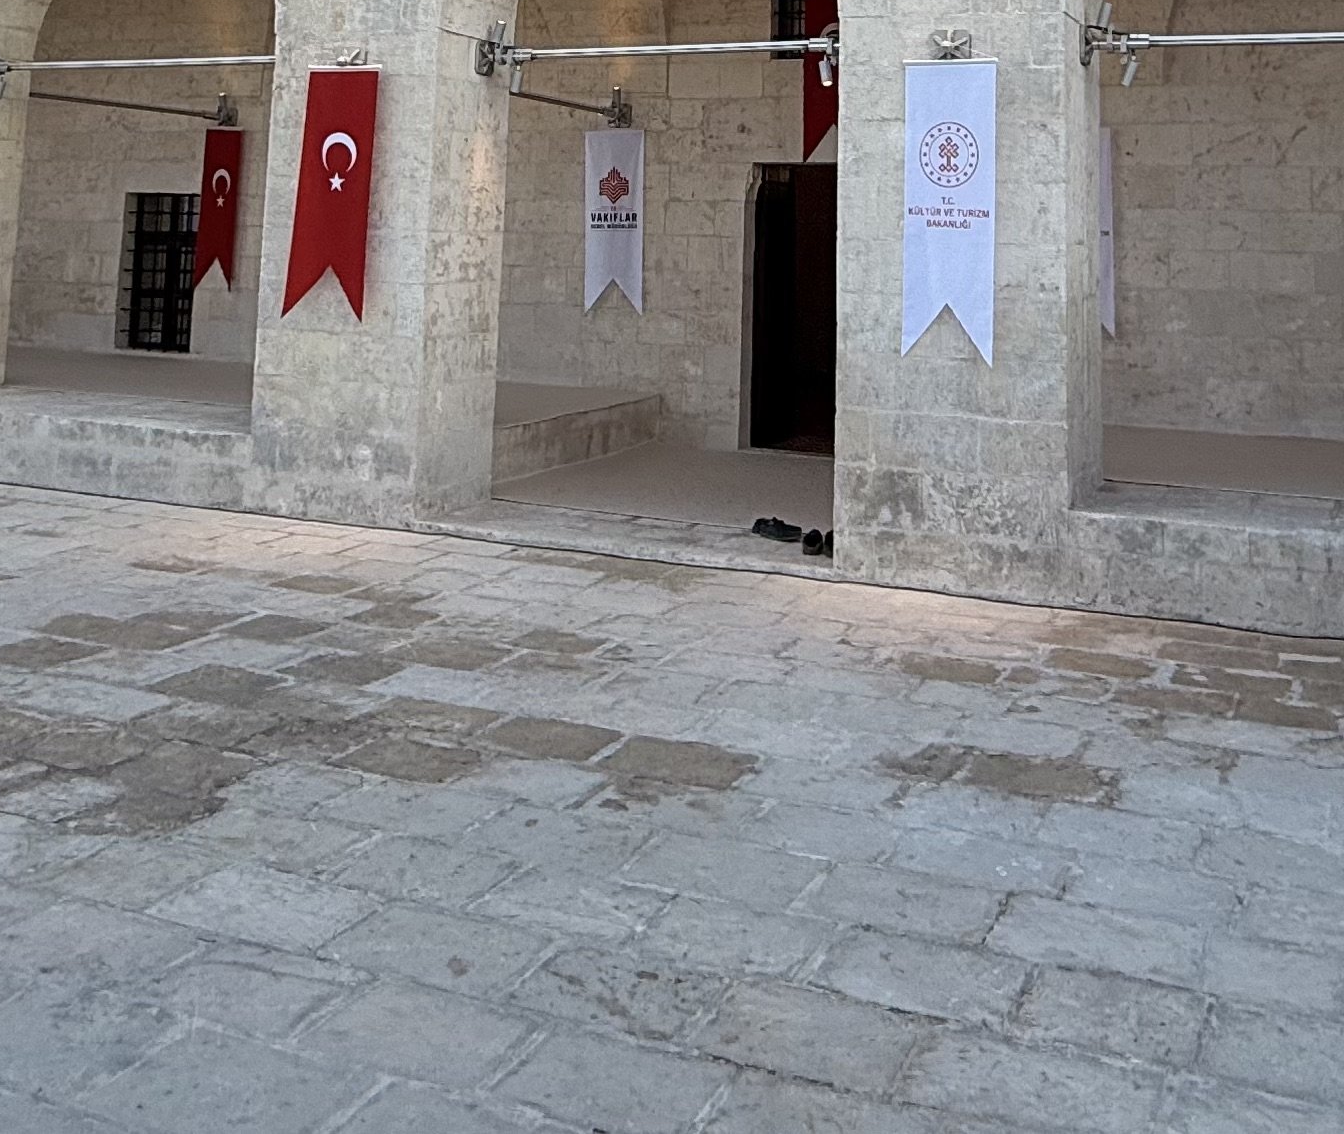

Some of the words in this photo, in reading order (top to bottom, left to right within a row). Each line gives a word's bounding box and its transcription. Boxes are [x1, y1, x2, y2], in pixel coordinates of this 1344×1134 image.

[908, 206, 941, 217] KÜLTÜR
[944, 208, 954, 217] VE
[591, 212, 637, 222] VAKIFLAR
